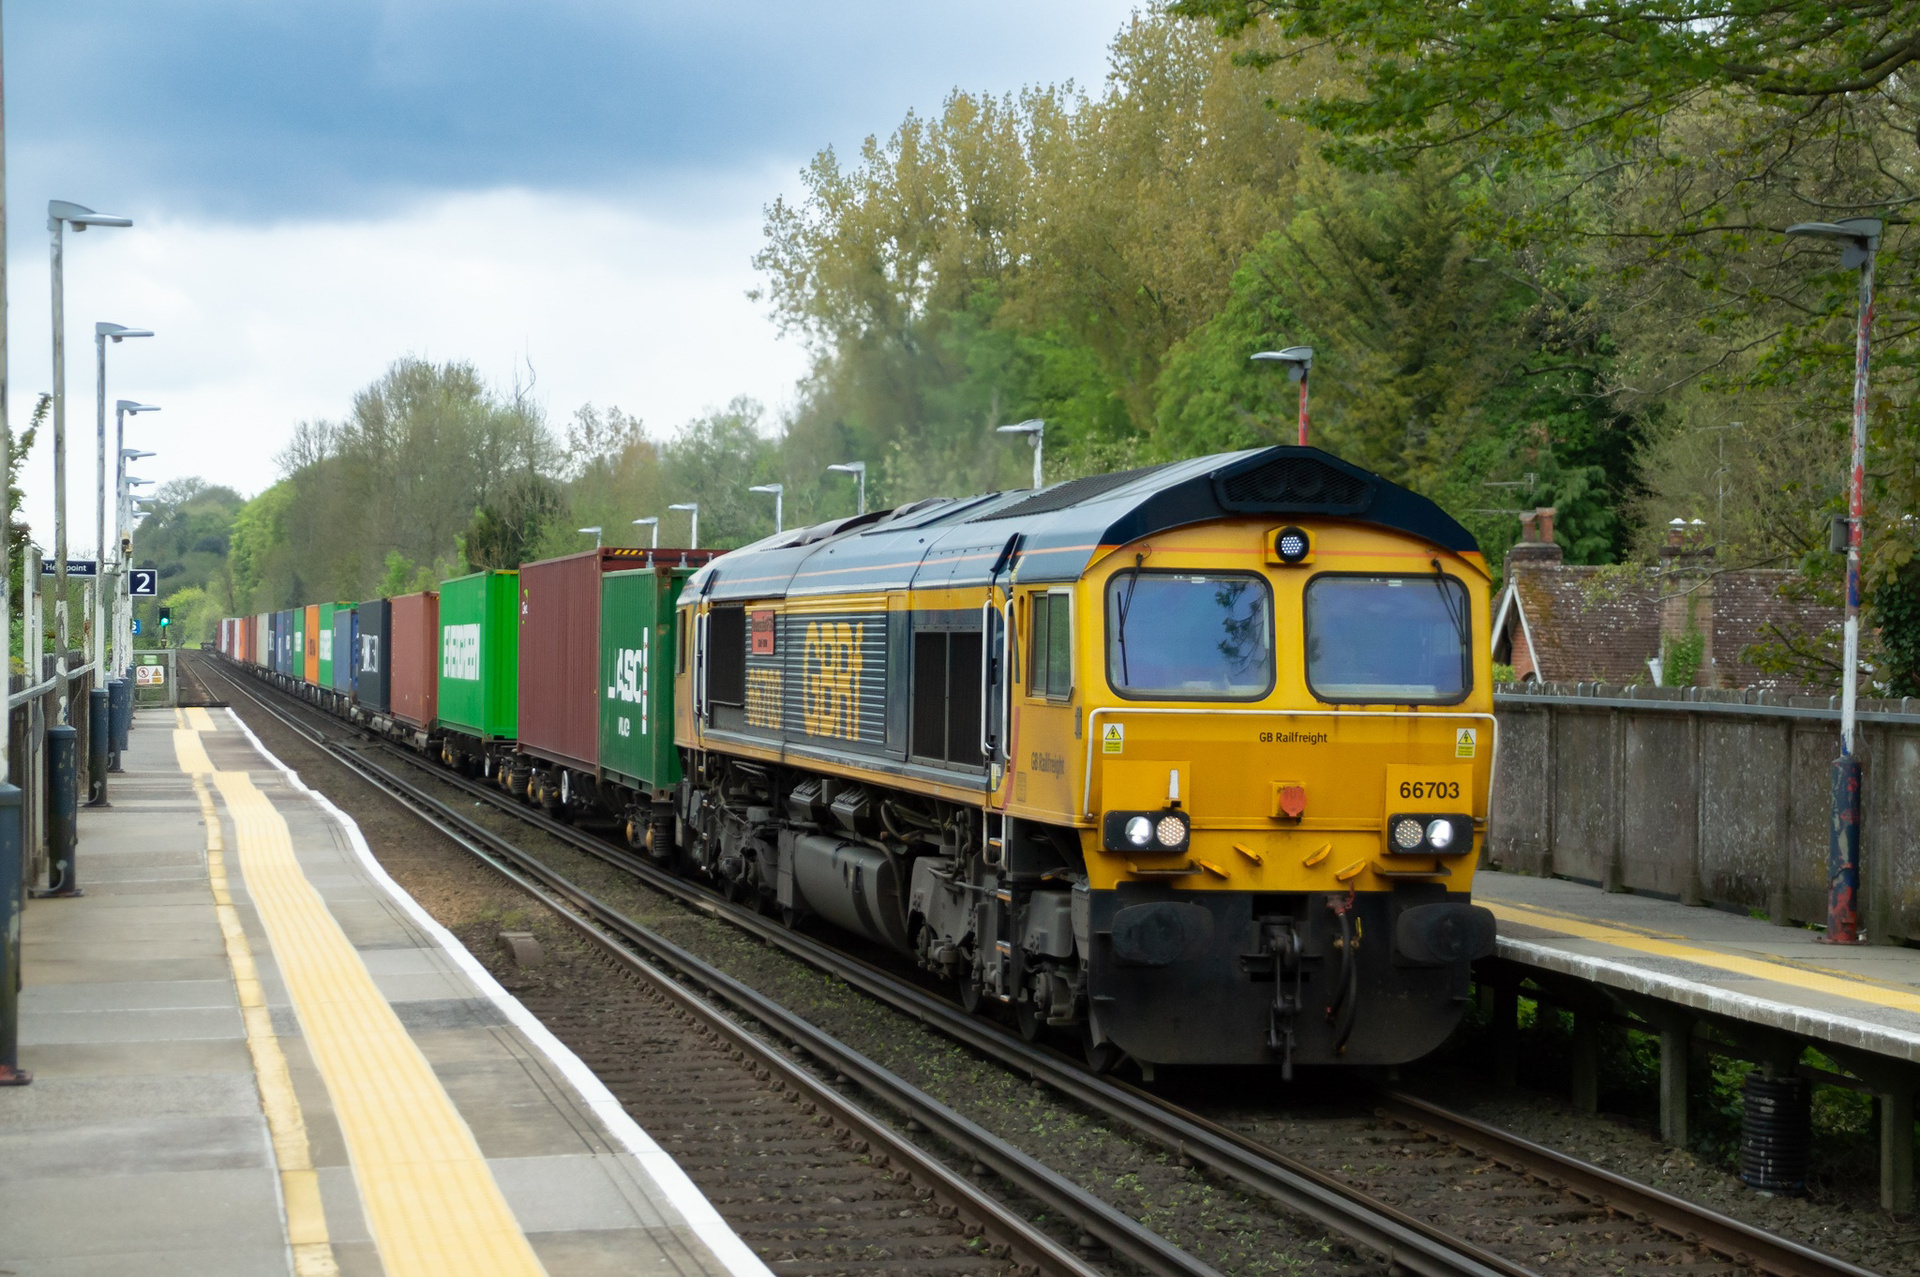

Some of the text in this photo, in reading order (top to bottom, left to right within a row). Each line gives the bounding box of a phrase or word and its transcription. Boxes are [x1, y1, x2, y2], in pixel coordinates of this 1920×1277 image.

[136, 572, 150, 593] 2
[1259, 732, 1328, 746] GB Railfreight
[1400, 781, 1460, 799] 66703
